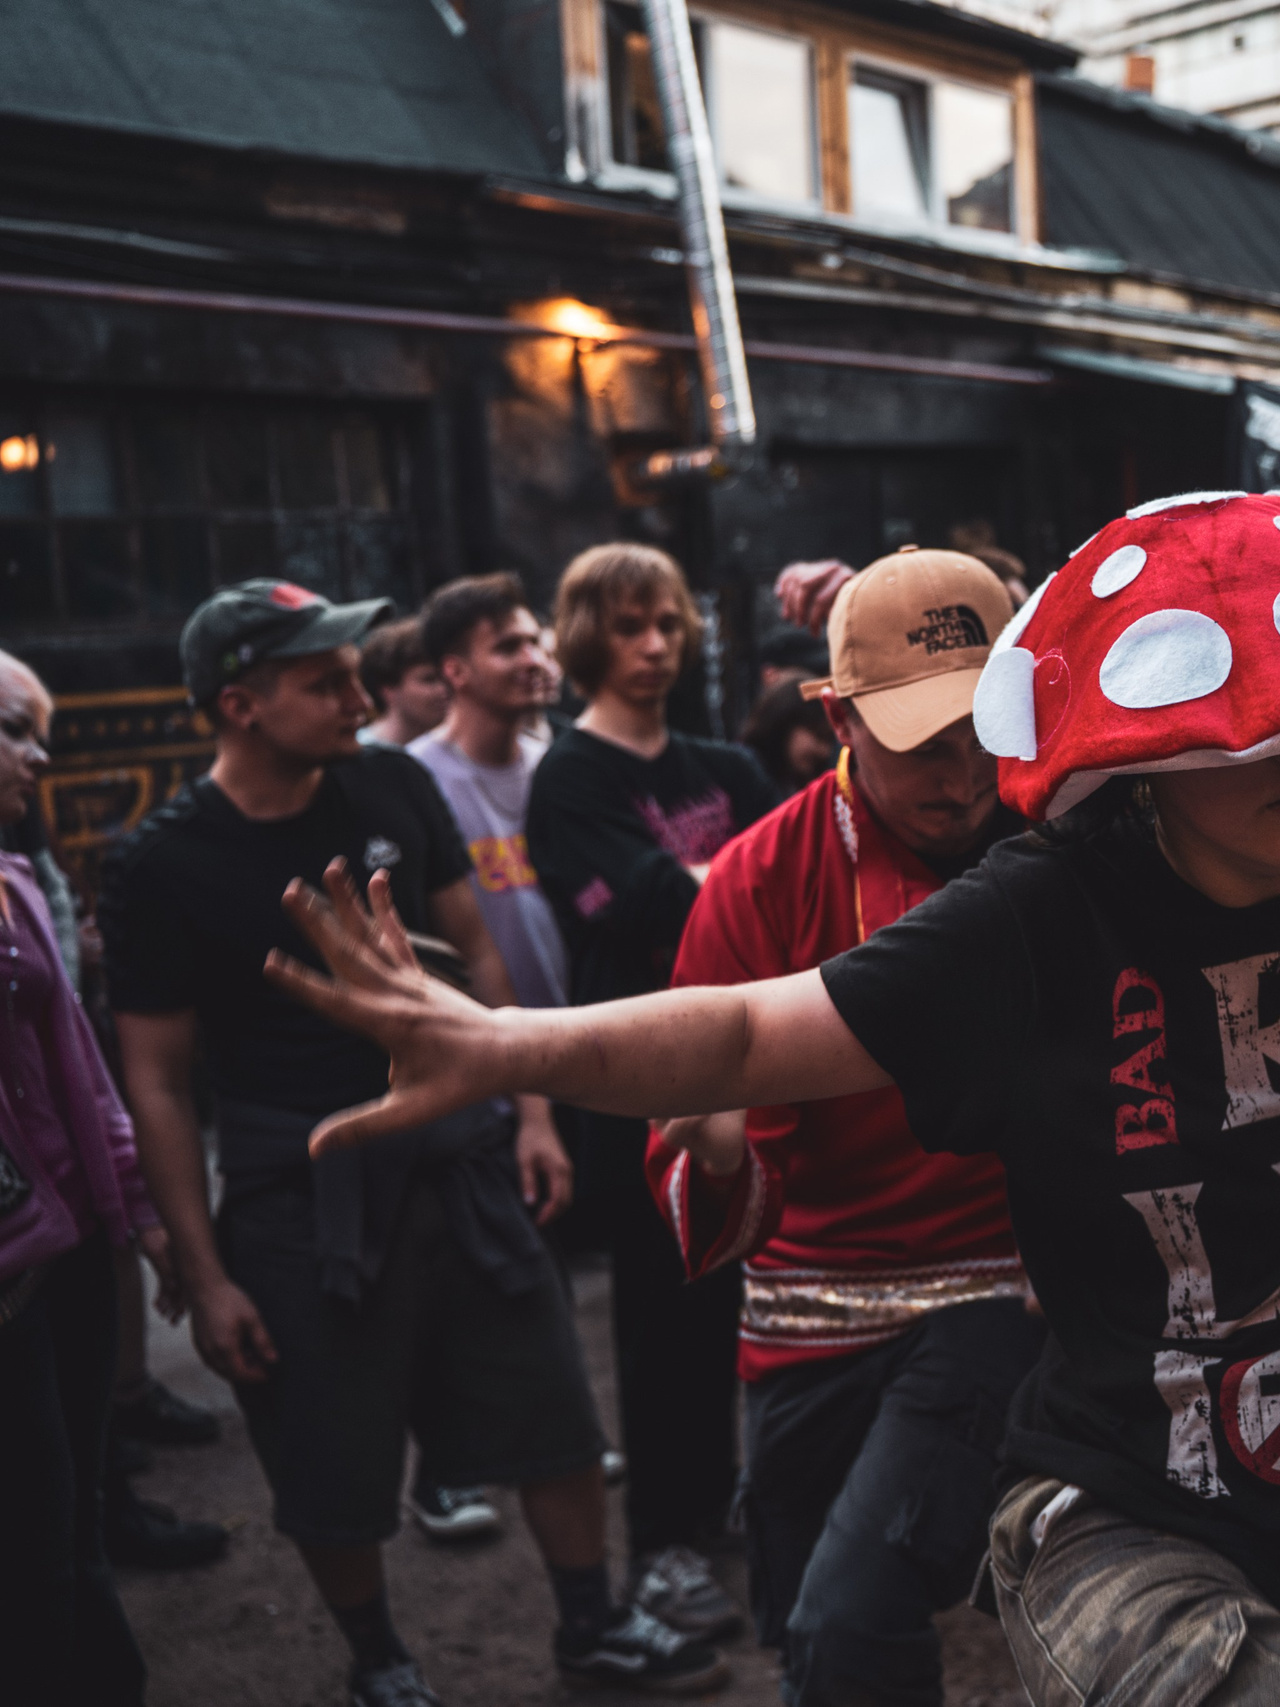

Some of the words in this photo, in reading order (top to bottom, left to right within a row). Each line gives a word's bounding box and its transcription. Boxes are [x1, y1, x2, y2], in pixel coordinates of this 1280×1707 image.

[924, 607, 958, 625] THE
[907, 622, 964, 645] NORTH
[926, 636, 966, 655] FACE
[1110, 966, 1180, 1155] BAD
